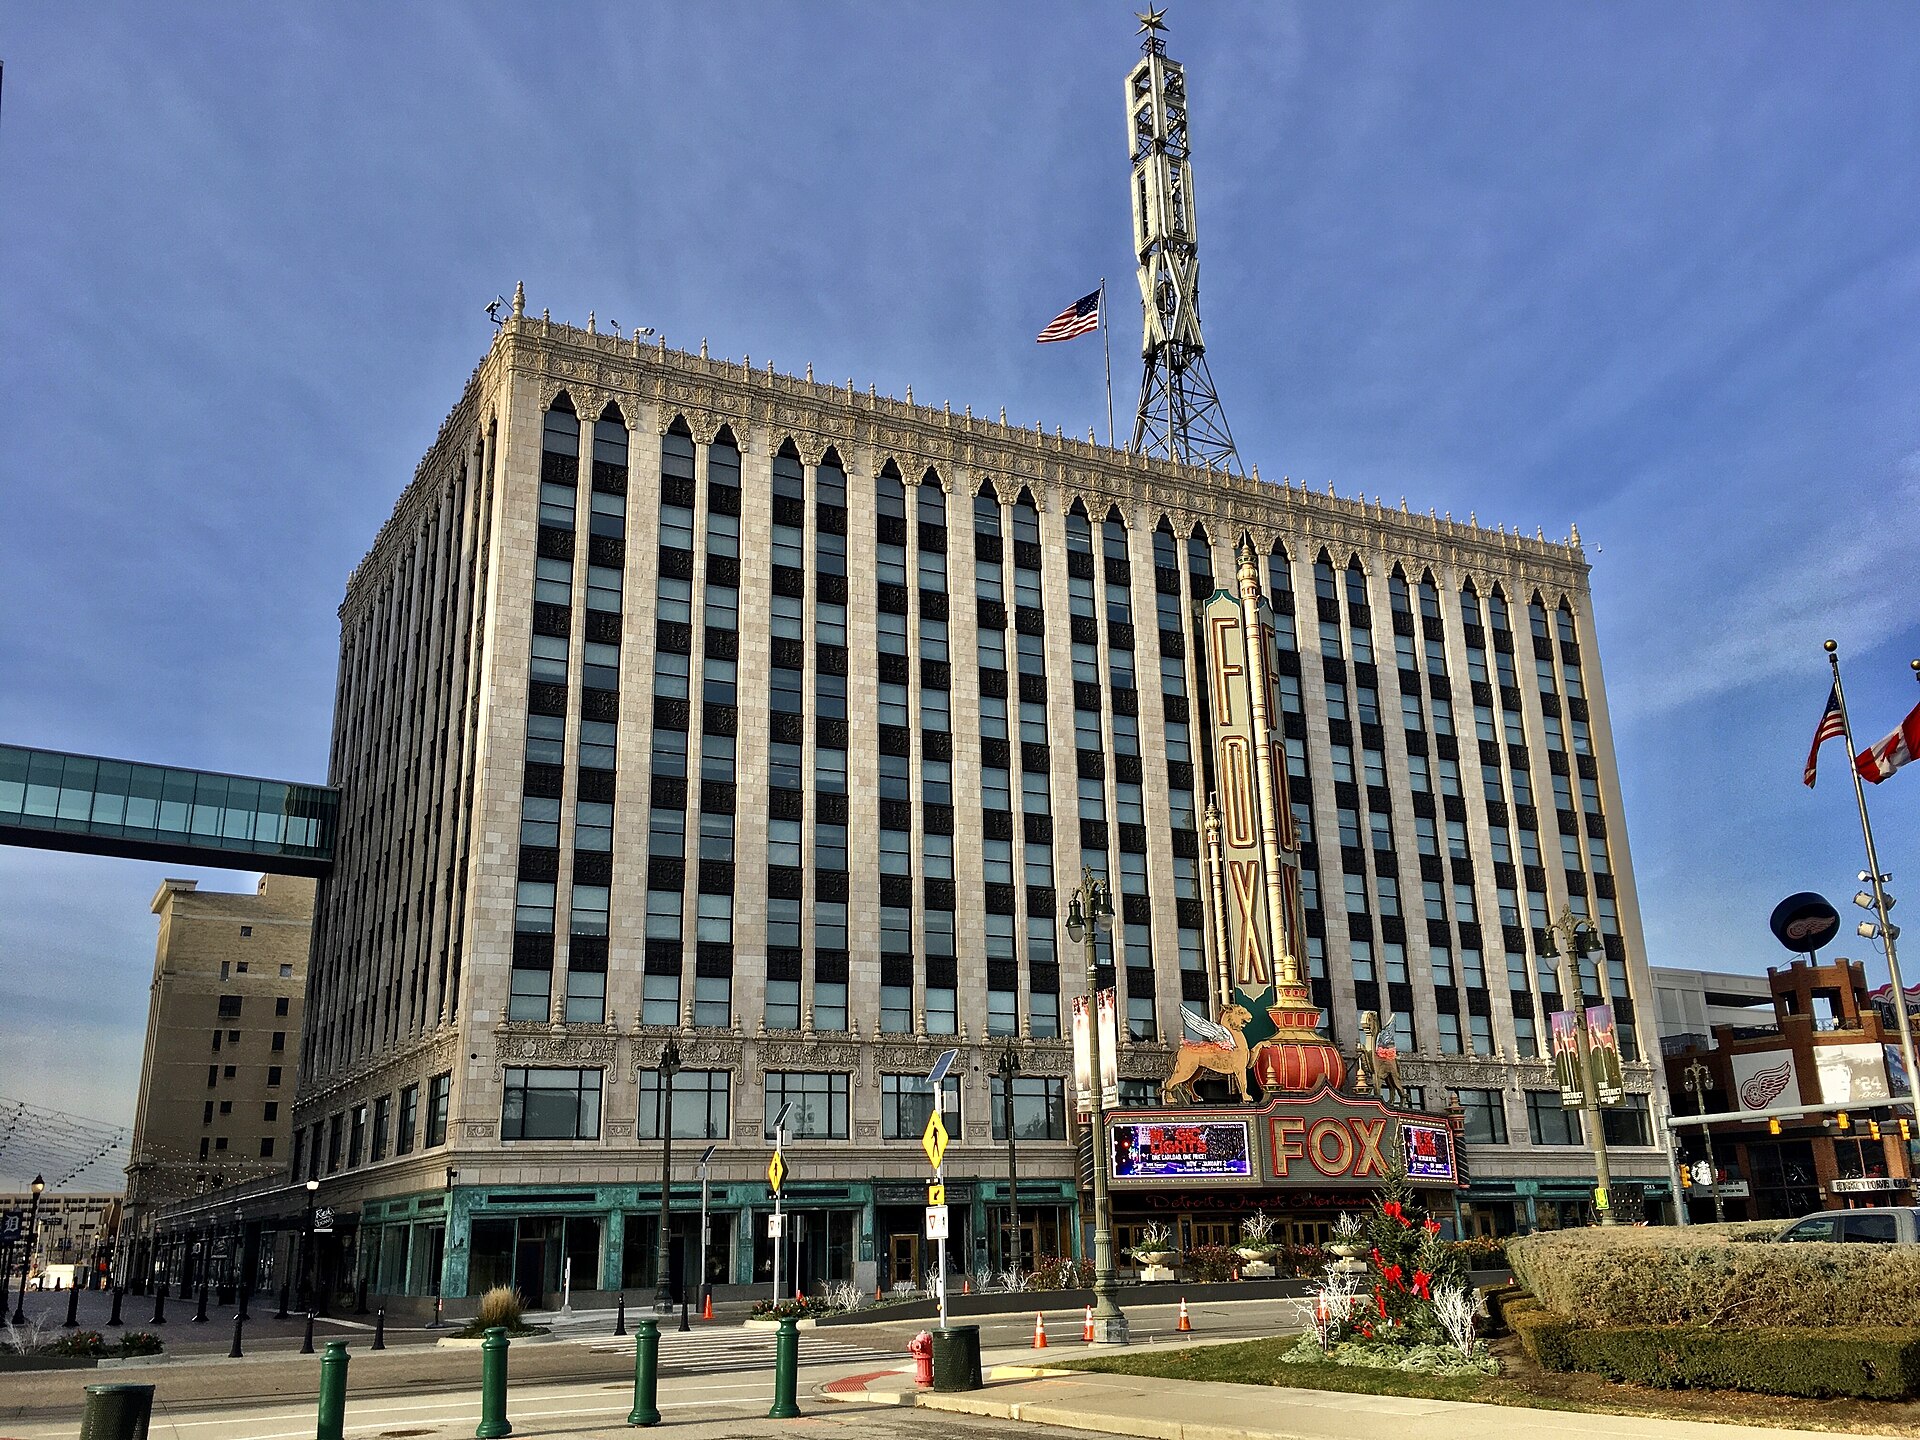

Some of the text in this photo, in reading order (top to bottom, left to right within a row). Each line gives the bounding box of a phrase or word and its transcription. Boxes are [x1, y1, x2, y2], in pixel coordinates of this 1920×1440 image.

[1212, 617, 1268, 985] FOX
[1261, 622, 1305, 981] FOX
[1149, 1127, 1200, 1141] MGIC
[1150, 1140, 1207, 1154] LIGHTS
[1269, 1116, 1390, 1177] FOX
[1146, 1194, 1224, 1208] Detroit's
